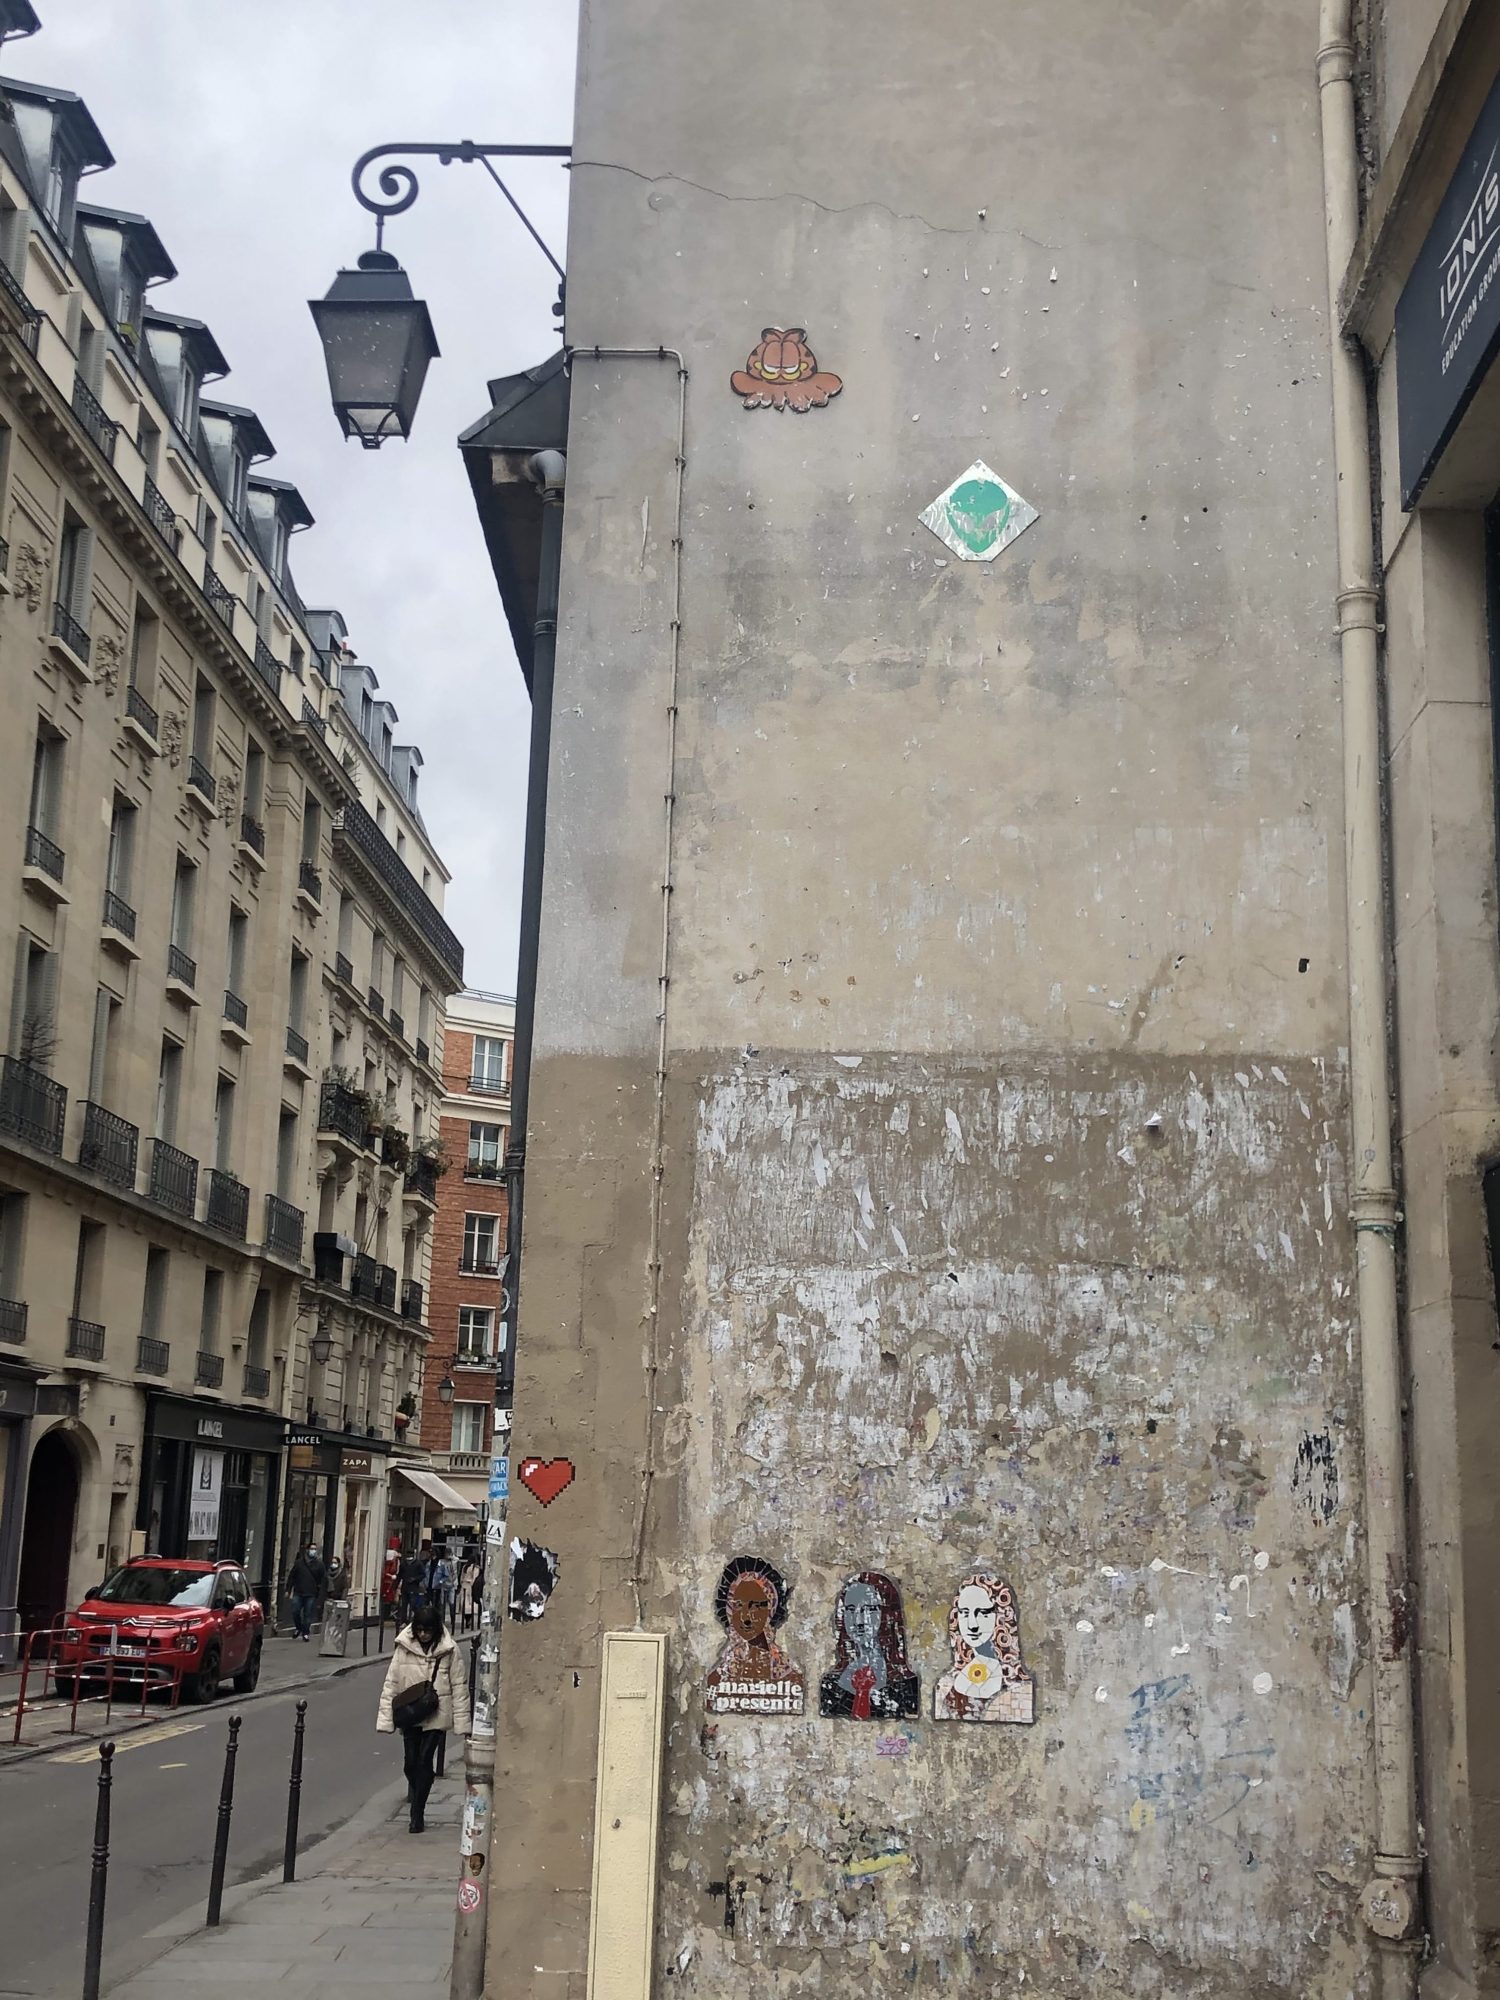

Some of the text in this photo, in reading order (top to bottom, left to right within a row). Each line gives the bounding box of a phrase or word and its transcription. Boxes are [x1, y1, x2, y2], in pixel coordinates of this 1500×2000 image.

[1440, 172, 1499, 319] IONIS
[1441, 294, 1478, 376] EDUCATION
[285, 1436, 321, 1445] LANCEL
[342, 1458, 368, 1467] ZAPA
